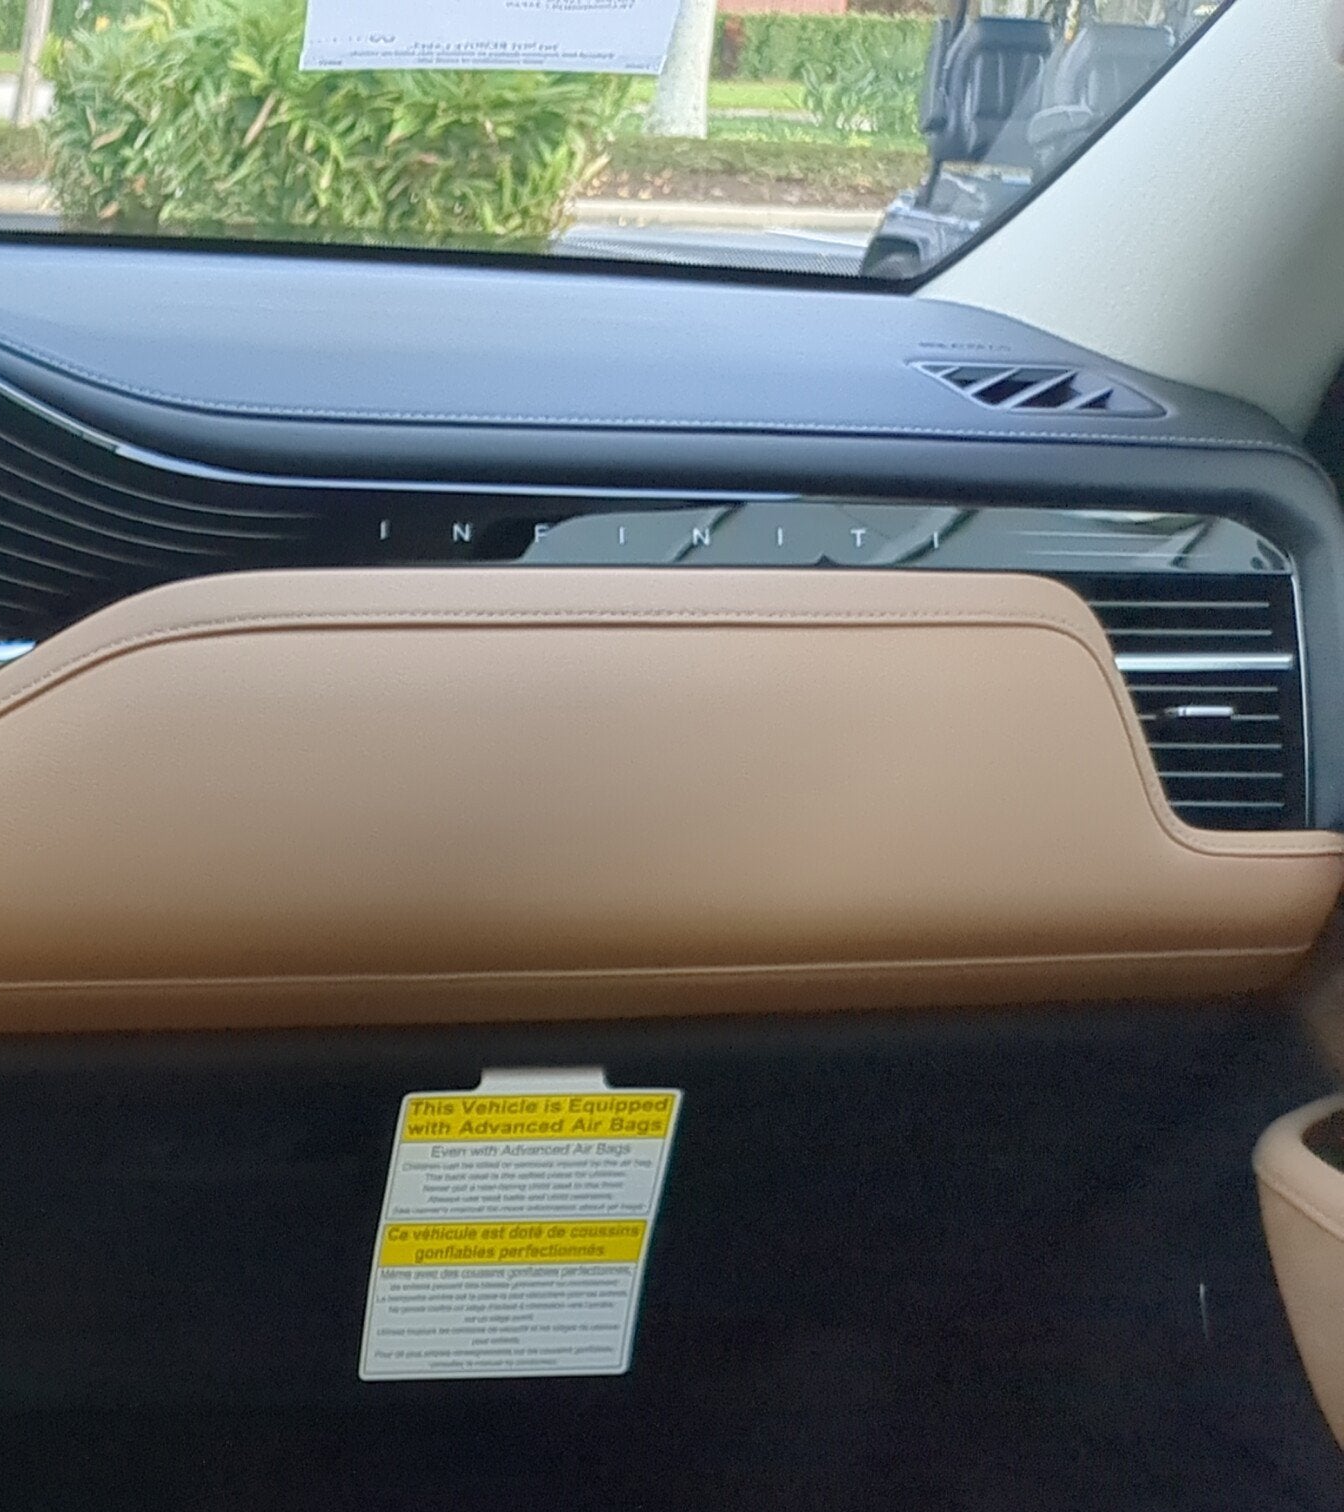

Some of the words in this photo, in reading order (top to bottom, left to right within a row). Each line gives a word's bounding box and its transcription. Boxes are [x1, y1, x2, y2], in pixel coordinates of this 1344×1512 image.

[380, 518, 940, 549] INFINITI
[412, 1100, 454, 1116] This
[462, 1099, 537, 1115] Vehicle
[544, 1098, 561, 1114] is
[568, 1097, 668, 1117] Equipped
[407, 1121, 450, 1136] with
[458, 1119, 564, 1135] Advanced
[570, 1117, 602, 1133] Air
[611, 1116, 662, 1135] Bags
[431, 1145, 466, 1159] Even
[470, 1144, 498, 1157] with
[501, 1143, 570, 1157] Advanced
[573, 1142, 593, 1156] Air
[596, 1141, 631, 1157] Bags
[388, 1227, 408, 1241] Ce
[413, 1226, 477, 1240] véhicule
[481, 1226, 505, 1240] est
[547, 1223, 566, 1239] de
[415, 1244, 495, 1263] gonflables
